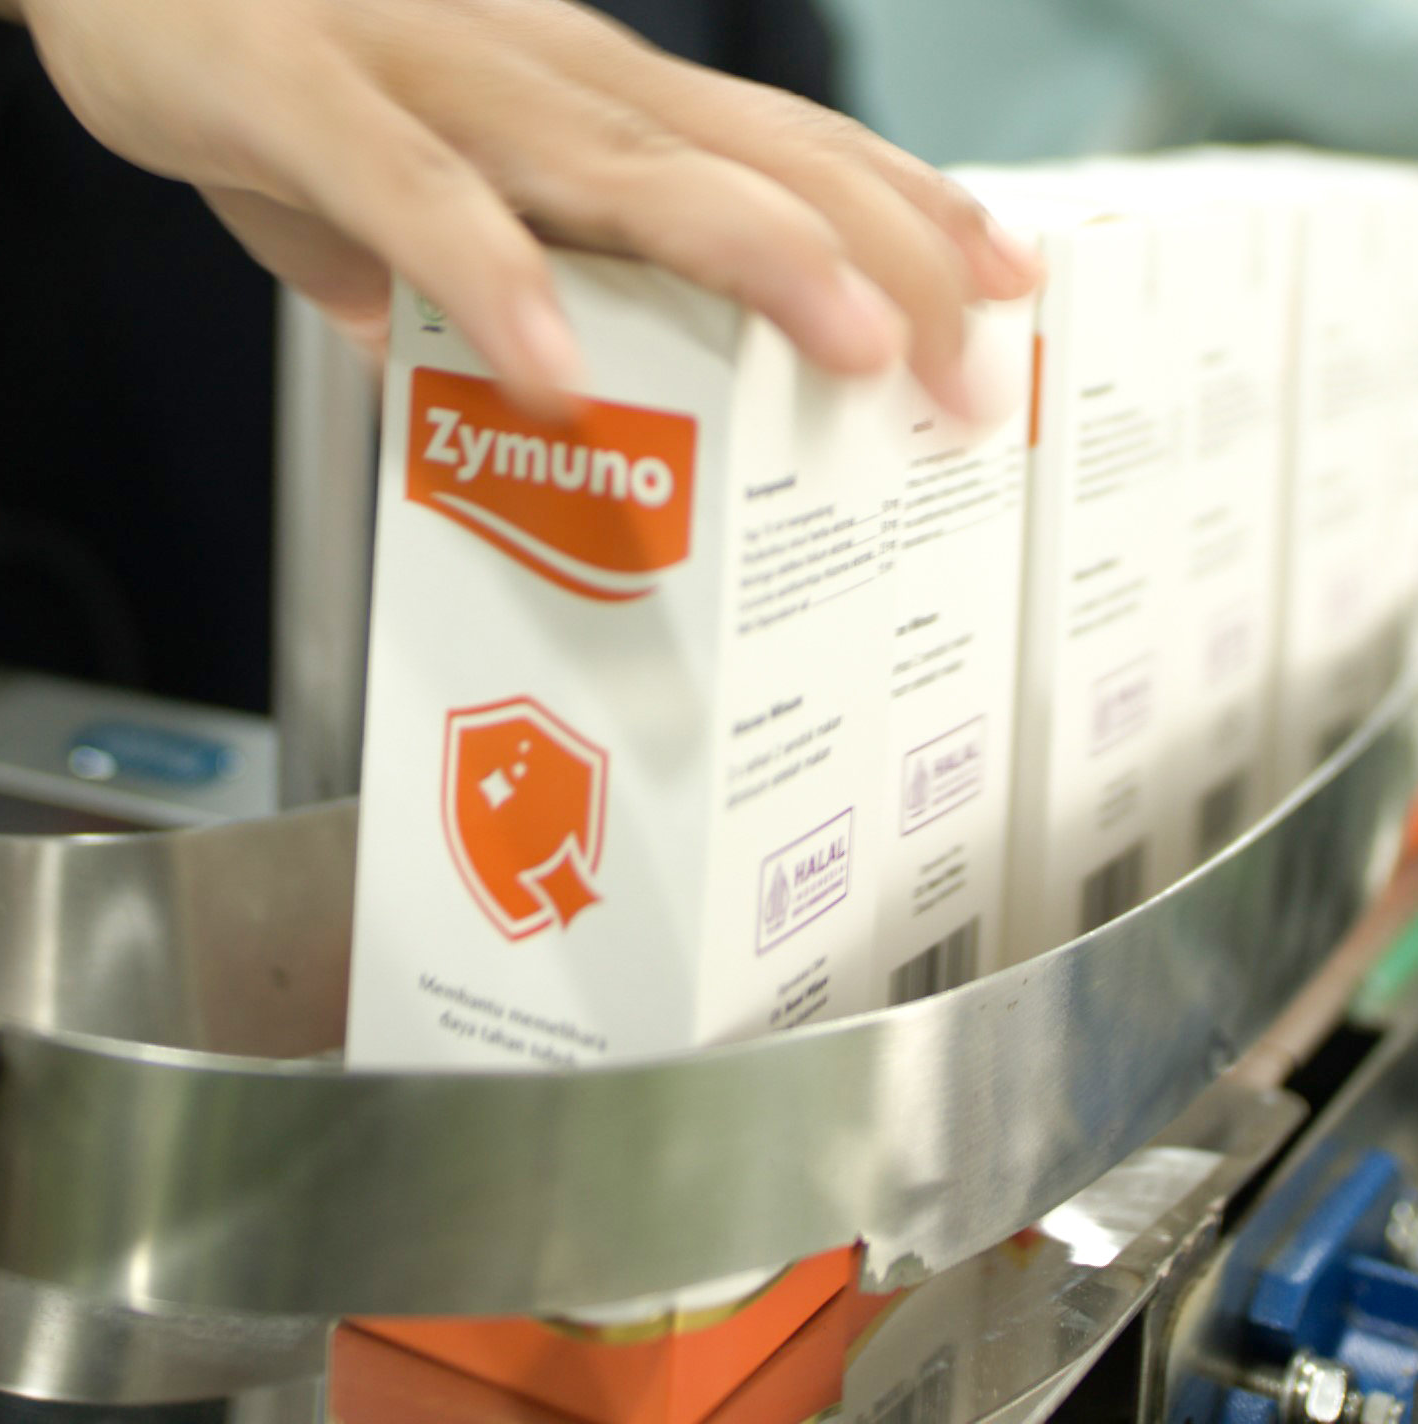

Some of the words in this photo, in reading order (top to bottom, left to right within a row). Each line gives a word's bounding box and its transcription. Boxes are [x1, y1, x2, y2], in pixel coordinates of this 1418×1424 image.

[423, 406, 674, 509] Zymuno
[793, 835, 845, 888] HALAL
[418, 972, 505, 1018] Membantu
[509, 1006, 608, 1053] memelihara
[438, 1010, 476, 1040] daya
[480, 1026, 525, 1054] tahan
